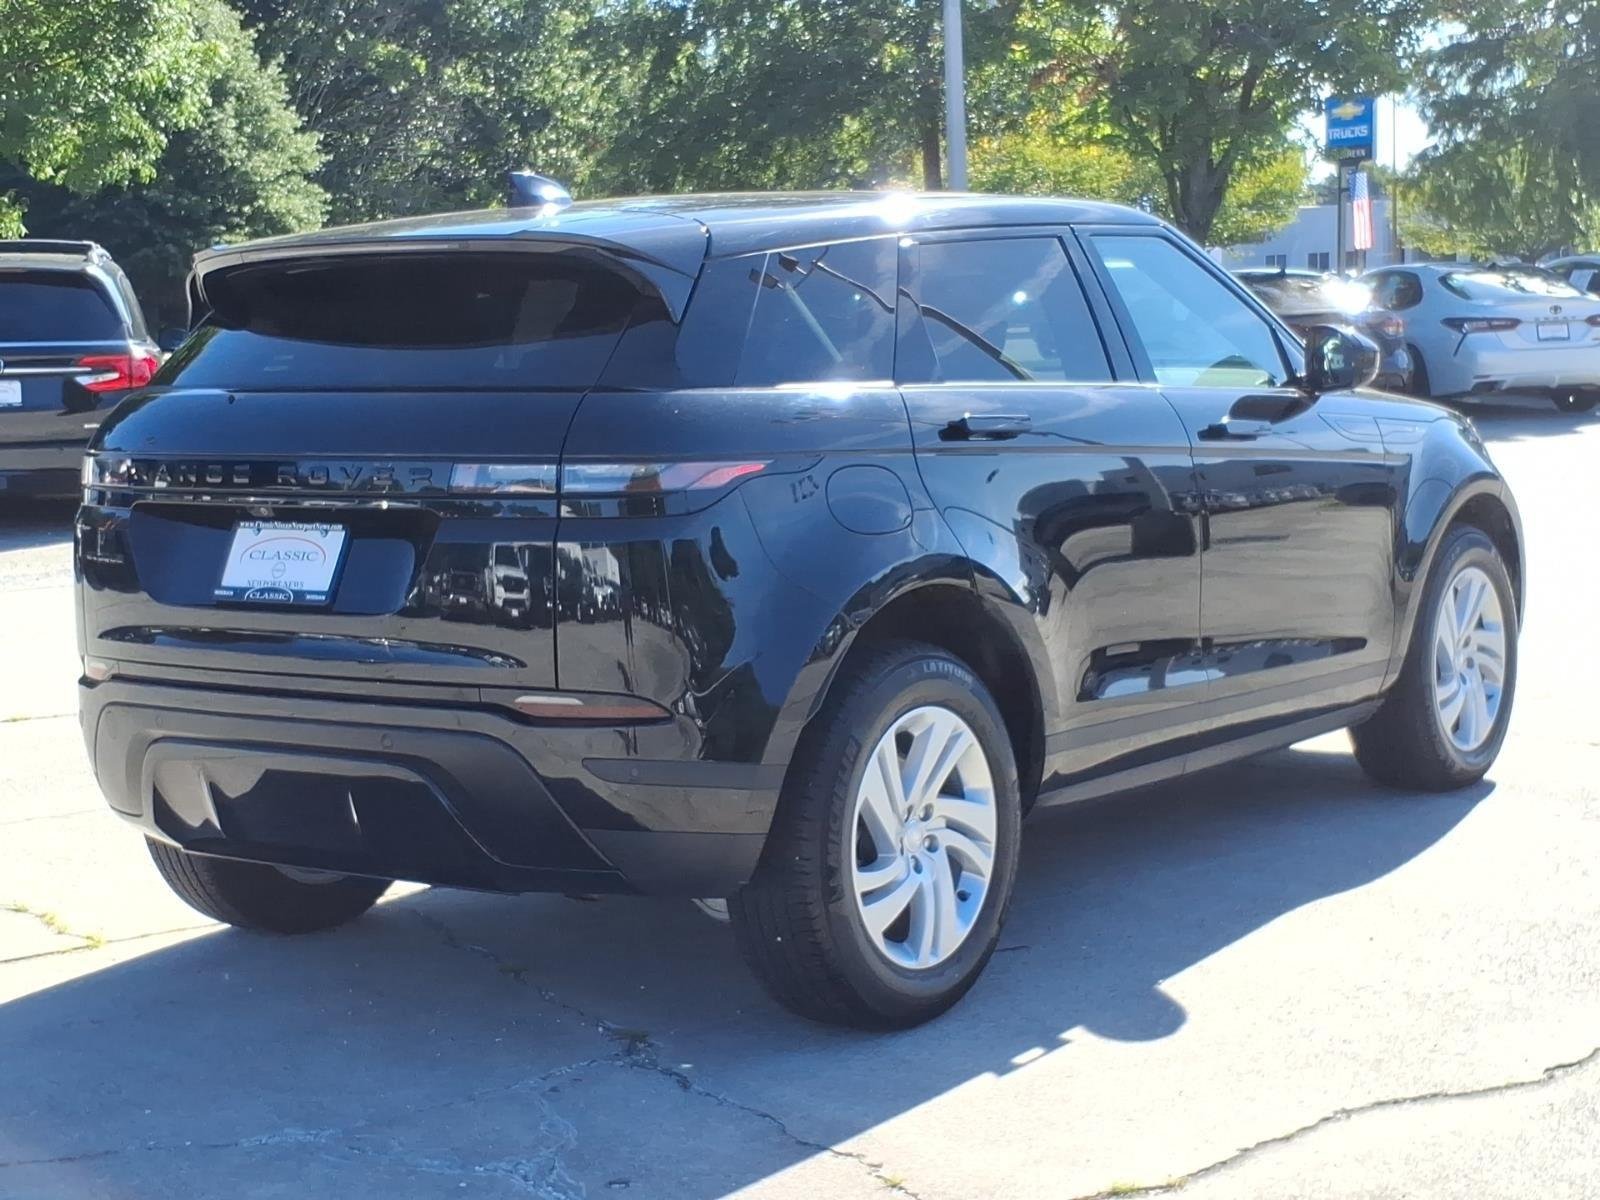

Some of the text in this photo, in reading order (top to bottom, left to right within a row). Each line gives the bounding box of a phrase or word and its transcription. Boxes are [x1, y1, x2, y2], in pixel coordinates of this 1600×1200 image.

[1328, 125, 1368, 140] TRUCKS
[276, 464, 433, 485] ROVER
[249, 550, 319, 562] CLASSIC
[249, 591, 290, 601] CLASSIC
